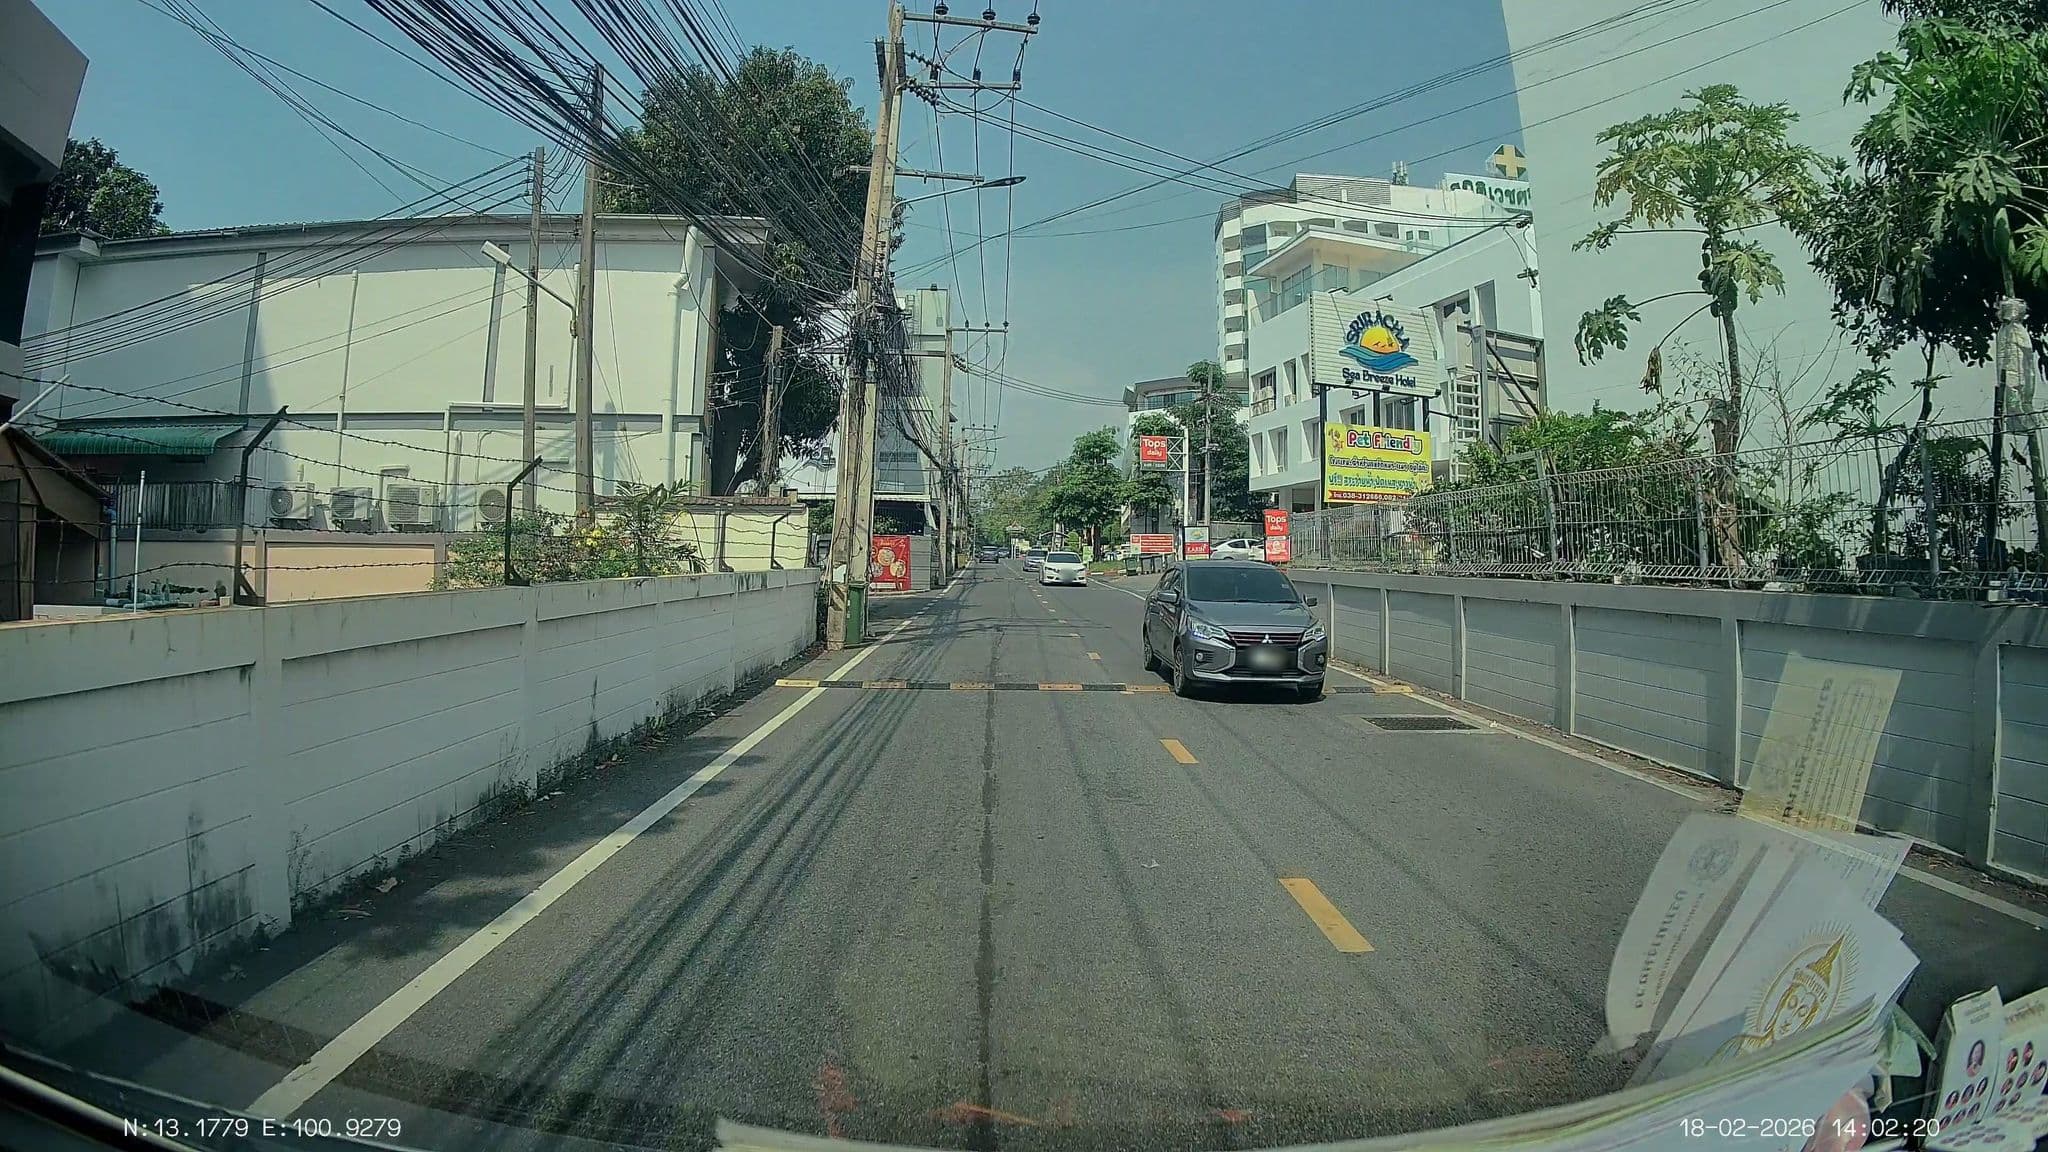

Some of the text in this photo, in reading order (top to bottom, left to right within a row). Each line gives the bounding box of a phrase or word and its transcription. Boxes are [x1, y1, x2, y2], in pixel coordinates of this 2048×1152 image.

[1347, 310, 1410, 351] SRIRACHA
[1342, 368, 1416, 388] Sea Breeze Hotel
[1142, 438, 1166, 449] Tops
[1347, 431, 1422, 455] Pet Friendly
[1146, 449, 1163, 457] daily
[1265, 515, 1287, 524] Tops
